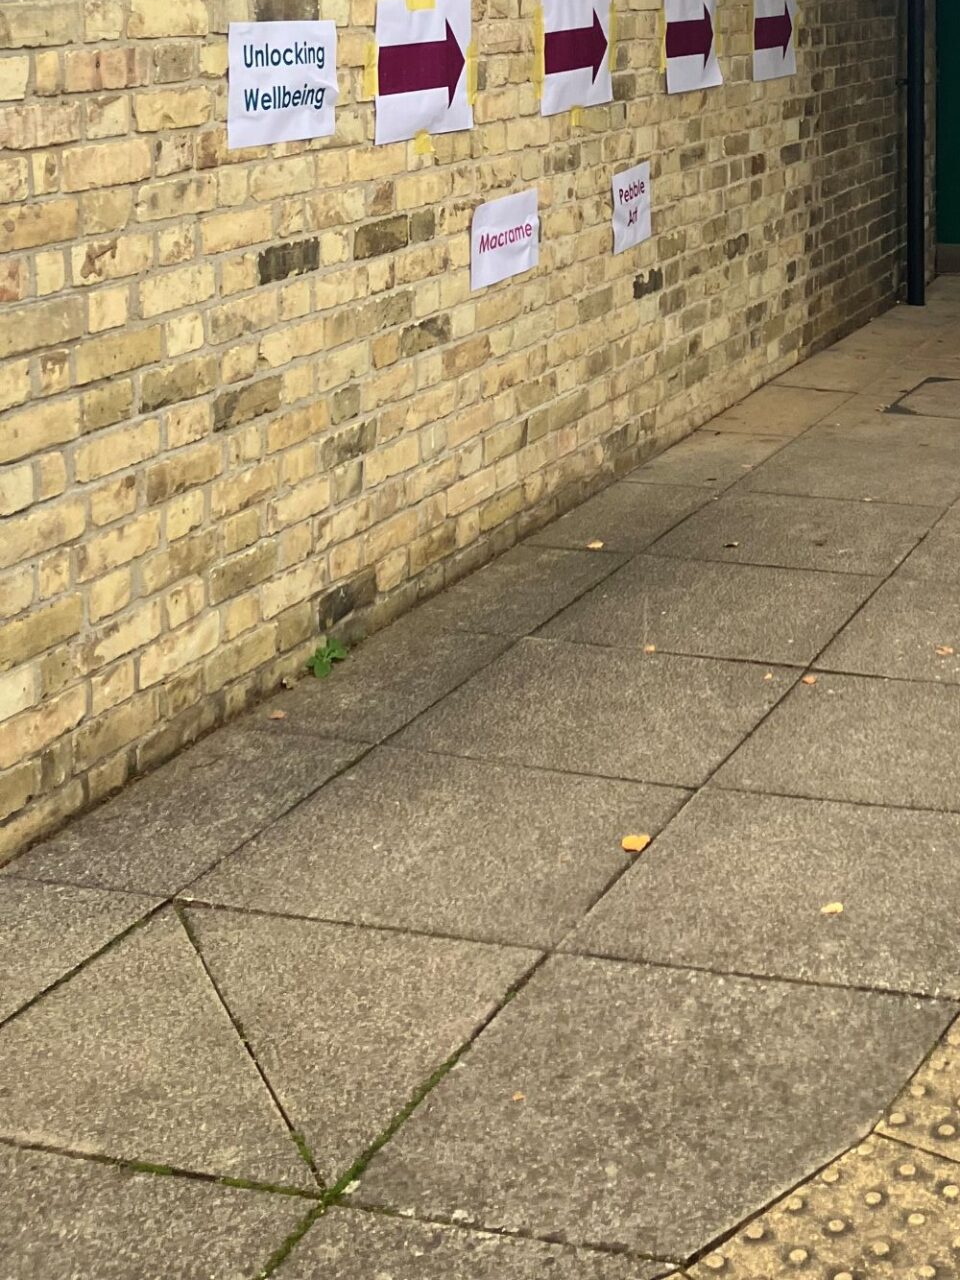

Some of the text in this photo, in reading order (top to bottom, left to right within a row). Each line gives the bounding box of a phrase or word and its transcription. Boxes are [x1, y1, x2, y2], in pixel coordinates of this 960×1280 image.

[243, 41, 325, 69] Unlocking
[244, 83, 326, 112] Wellbeing
[618, 179, 645, 205] Pebble
[627, 206, 638, 227] Art
[479, 222, 532, 254] Macrame
